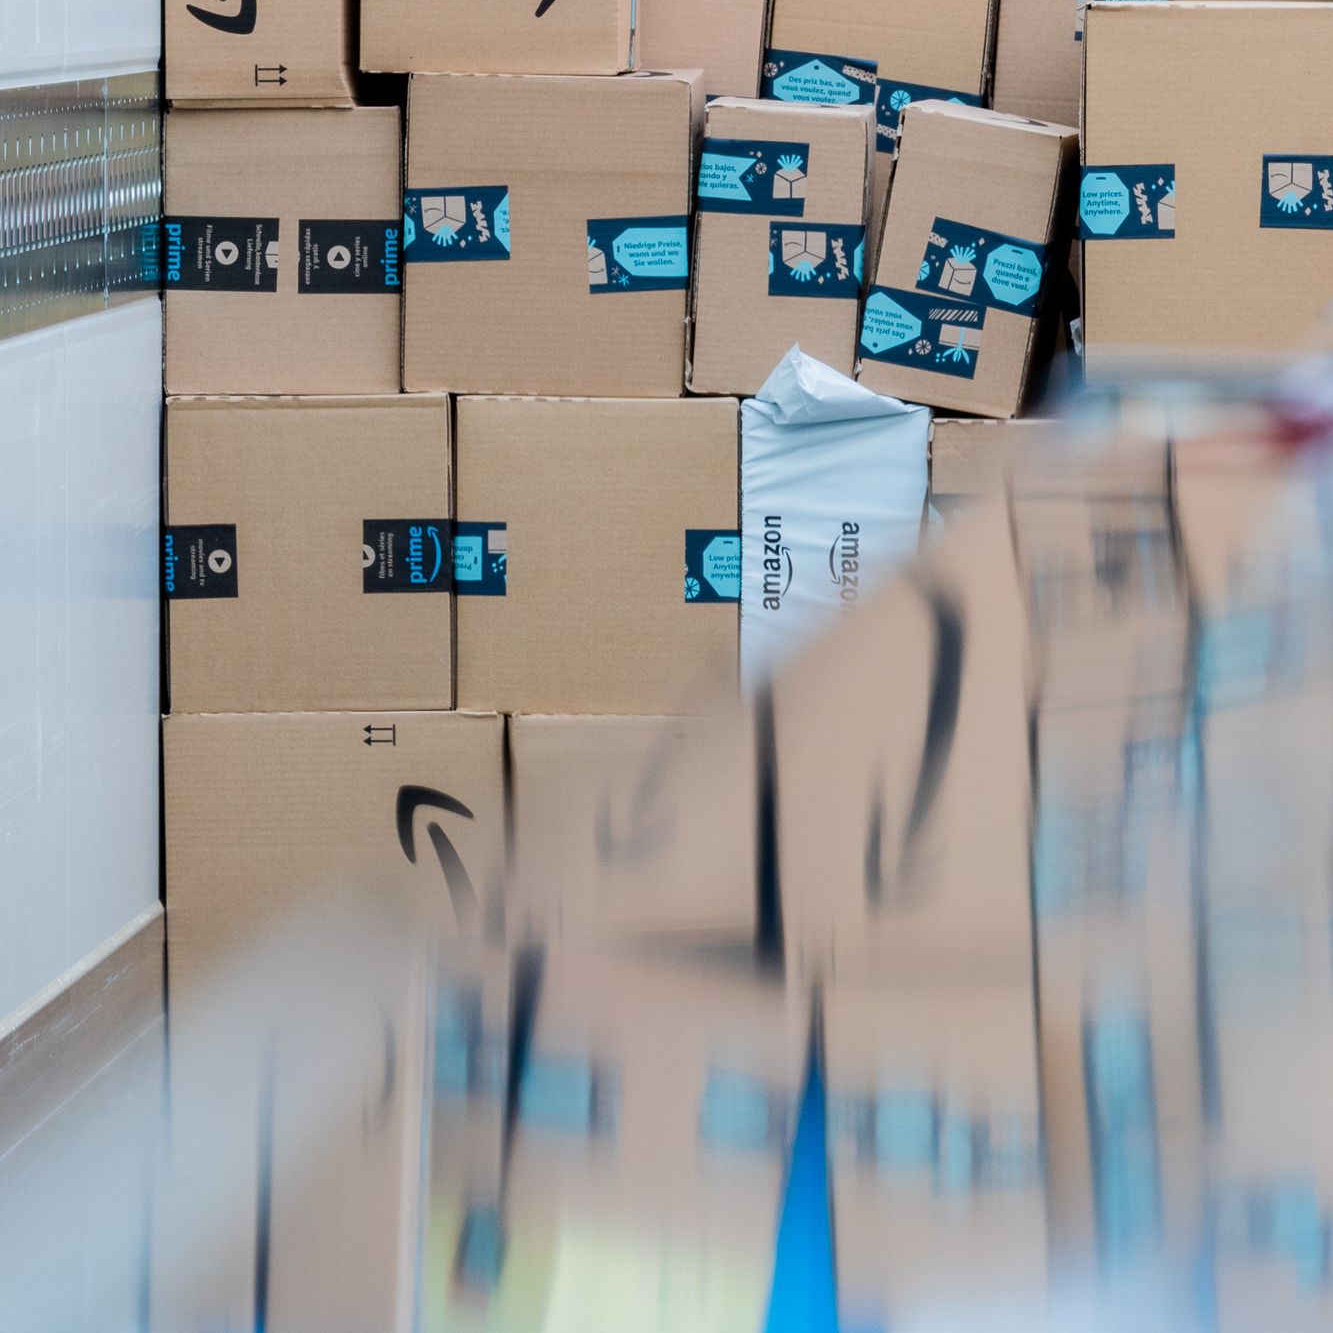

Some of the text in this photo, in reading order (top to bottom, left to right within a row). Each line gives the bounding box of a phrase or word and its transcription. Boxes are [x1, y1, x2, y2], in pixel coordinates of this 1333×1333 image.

[1082, 189, 1124, 199] Low prices.
[1086, 198, 1120, 208] Anytime,
[1084, 207, 1123, 217] anywhere.
[164, 223, 186, 281] prime
[311, 243, 320, 263] gratis
[623, 239, 683, 250] Niedrige Preise,
[650, 248, 666, 257] und
[303, 227, 312, 285] entregas rápidas
[379, 227, 400, 286] prime
[633, 257, 675, 267] Sie wollen.
[992, 257, 1037, 277] Prezzi bassi,
[994, 268, 1024, 281] quando
[991, 275, 1029, 292] dove vuoi.
[404, 525, 427, 584] prime
[763, 515, 782, 611] amazon
[840, 521, 860, 613] amazo
